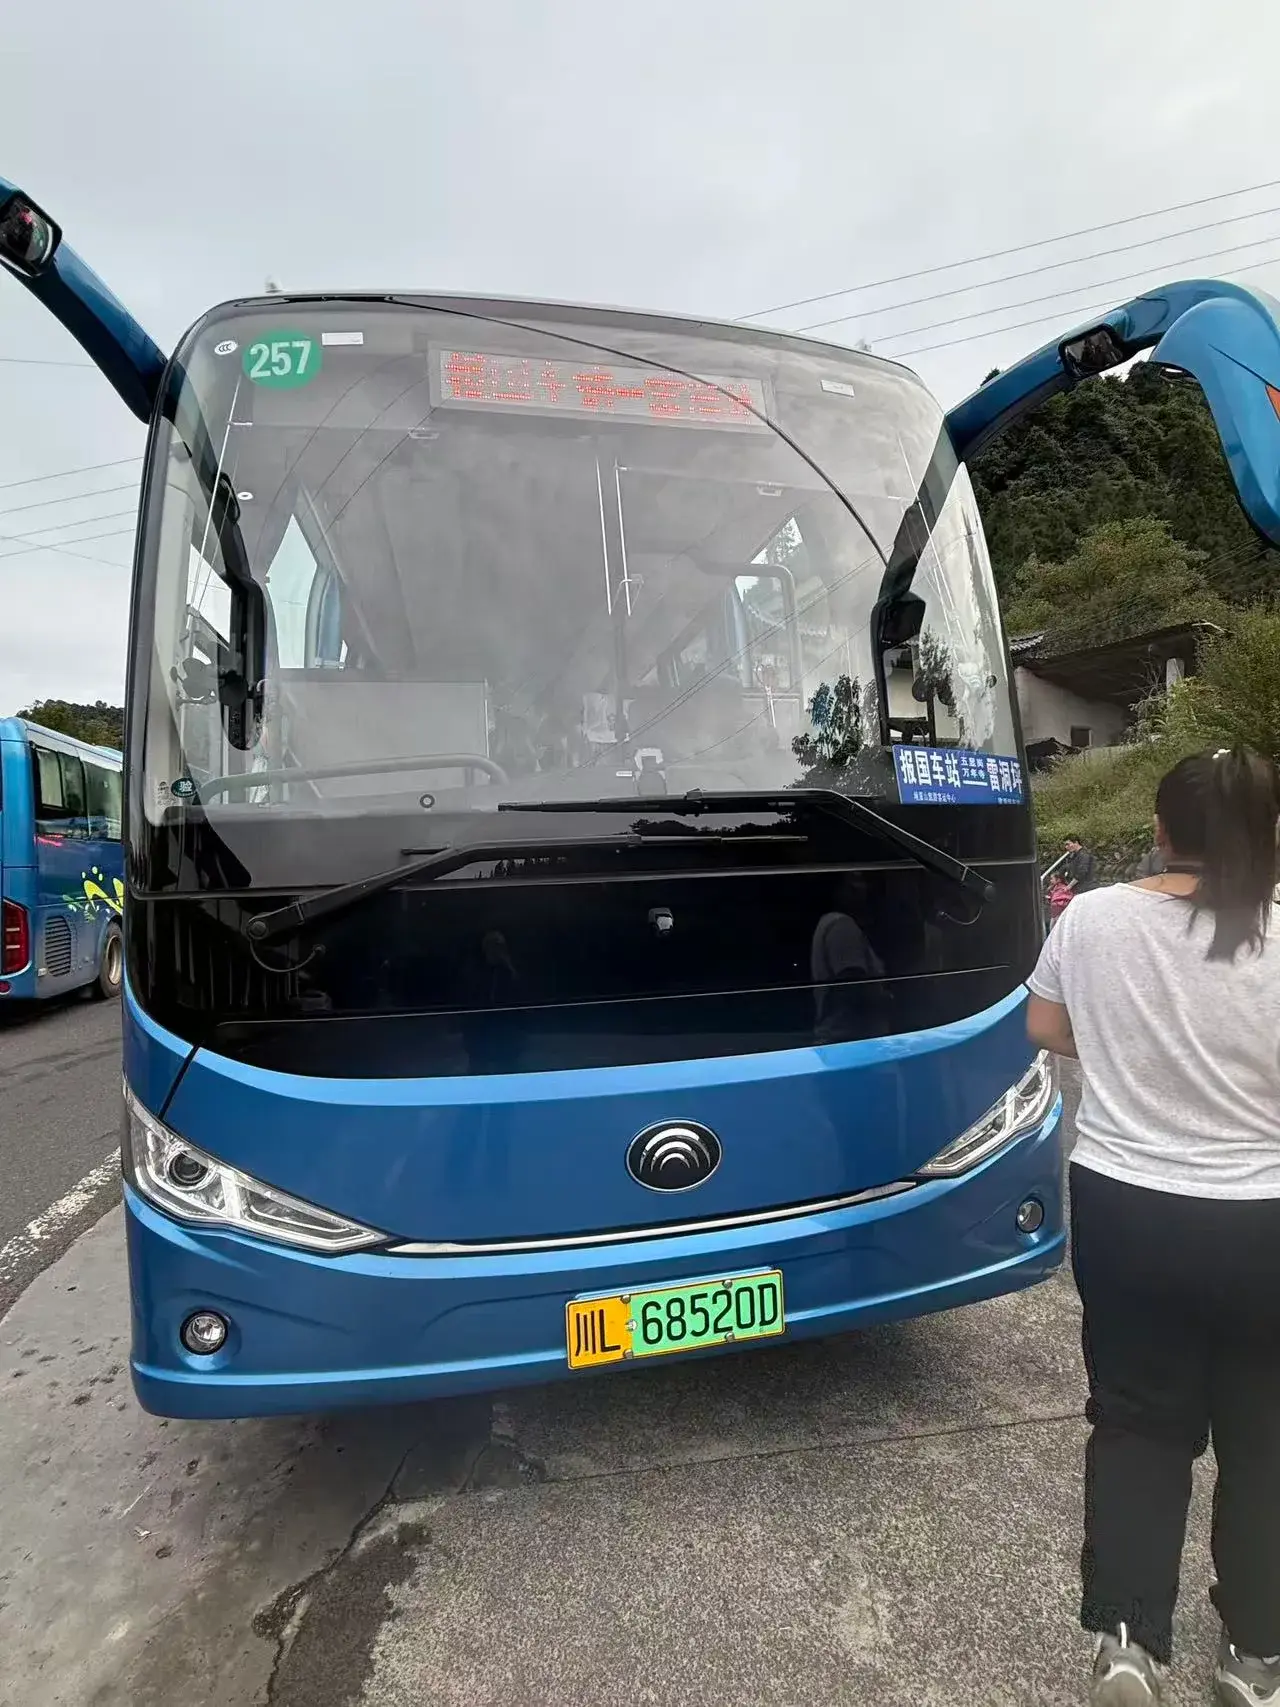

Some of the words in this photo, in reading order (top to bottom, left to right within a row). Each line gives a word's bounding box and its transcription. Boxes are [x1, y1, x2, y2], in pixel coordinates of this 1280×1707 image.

[249, 340, 312, 378] 257
[900, 749, 961, 788] 报国车站
[960, 757, 984, 768] 五显岗
[962, 768, 985, 780] 万年寺
[986, 757, 1022, 794] 雷洞坪
[575, 1308, 621, 1357] 川L
[641, 1282, 778, 1345] 68520D
